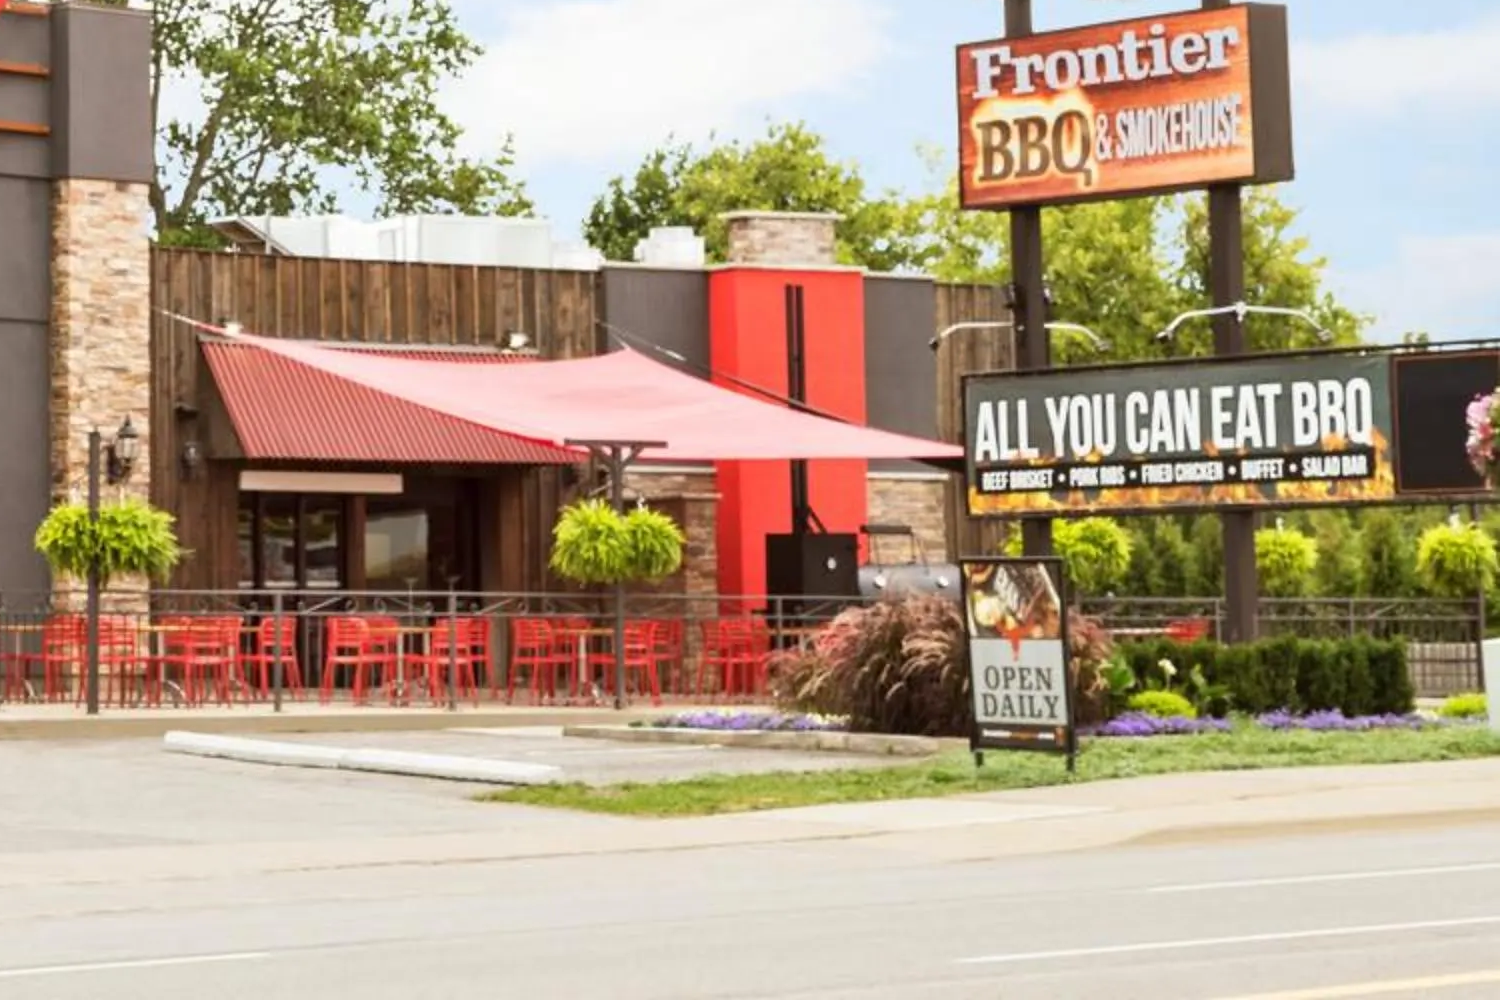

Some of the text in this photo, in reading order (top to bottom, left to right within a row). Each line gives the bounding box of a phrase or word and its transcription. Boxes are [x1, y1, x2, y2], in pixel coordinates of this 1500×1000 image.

[971, 24, 1239, 99] Frontier
[976, 93, 1241, 187] BBQ & SMOKEHOUSE
[975, 377, 1374, 462] ALL YOU CAN EAT BBQ
[982, 693, 1059, 719] DAILY
[984, 665, 1052, 691] OPEN
